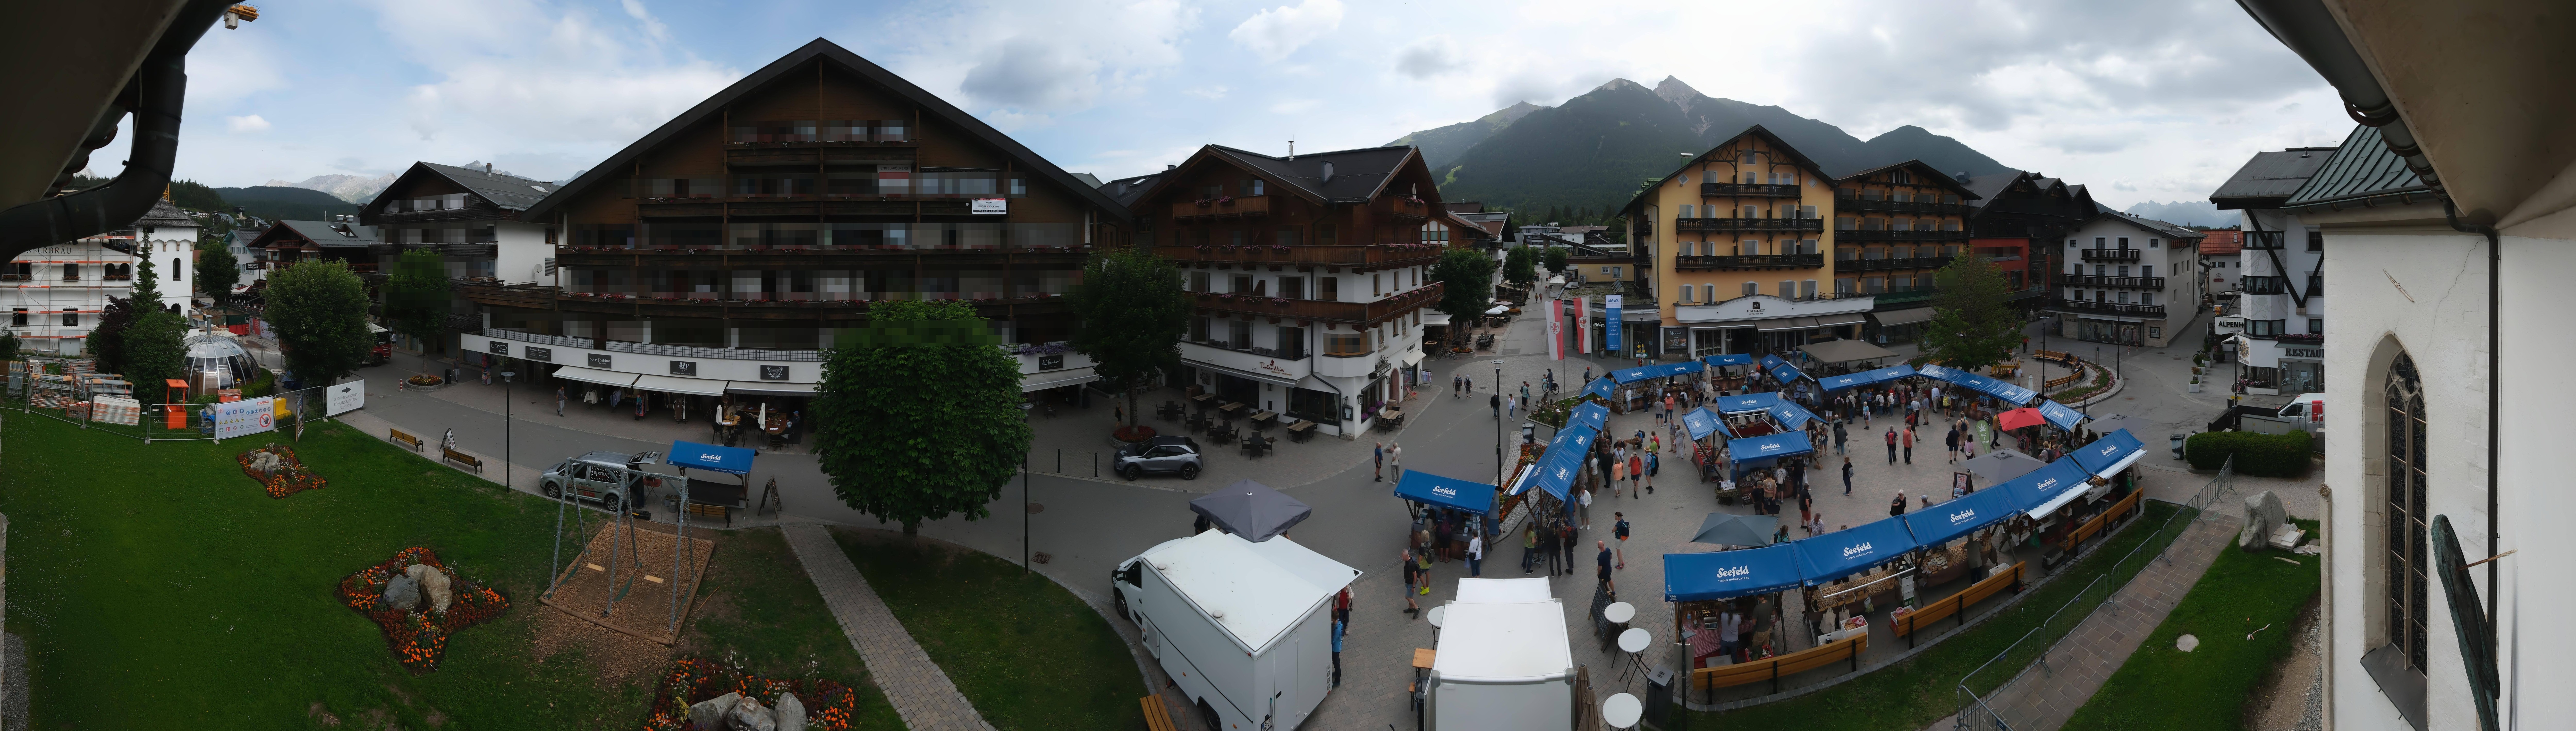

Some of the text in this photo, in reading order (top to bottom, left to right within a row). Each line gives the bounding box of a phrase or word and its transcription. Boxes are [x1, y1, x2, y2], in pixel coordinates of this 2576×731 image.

[1407, 343, 1416, 352] SAILER
[1377, 364, 1391, 378] RESTAURANT
[334, 397, 358, 406] KONGRESSZENTRUM
[2102, 445, 2116, 455] Seefeld
[1557, 467, 1566, 479] Seefeld
[2037, 477, 2056, 489] Seefeld
[1433, 486, 1456, 495] Seefeld
[1951, 508, 1975, 522] Seefeld
[1843, 541, 1872, 556] Seefeld
[1716, 565, 1749, 578] Seefeld
